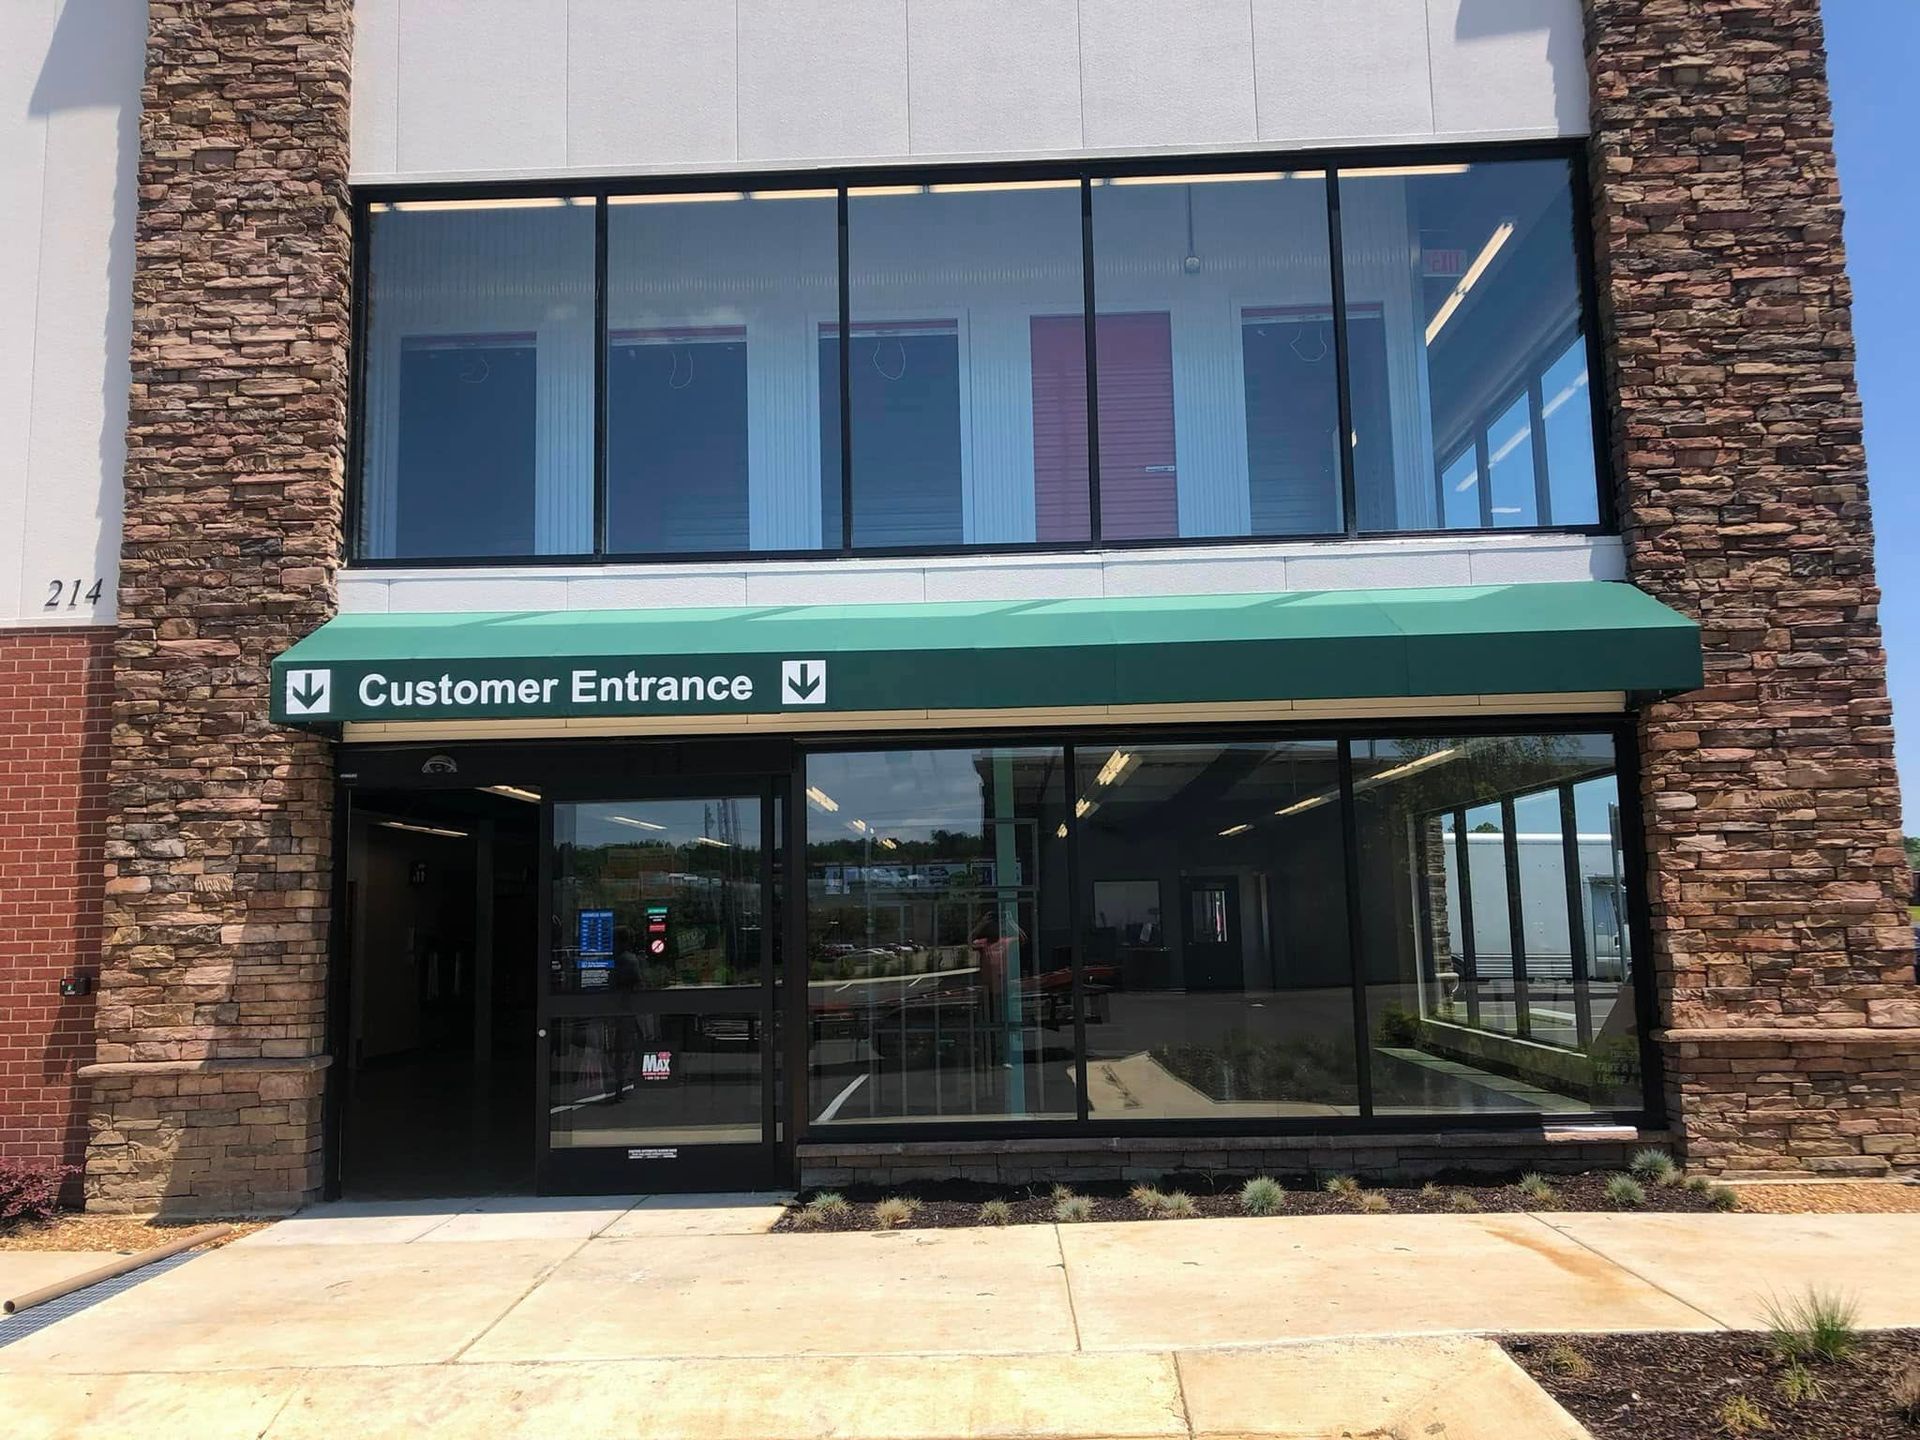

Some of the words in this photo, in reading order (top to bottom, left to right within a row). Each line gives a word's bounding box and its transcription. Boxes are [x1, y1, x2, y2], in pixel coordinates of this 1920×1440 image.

[1431, 251, 1462, 272] EXIT
[44, 578, 103, 606] 214
[358, 673, 560, 706] Customer
[571, 669, 753, 703] Entrance
[642, 1054, 671, 1072] MAX
